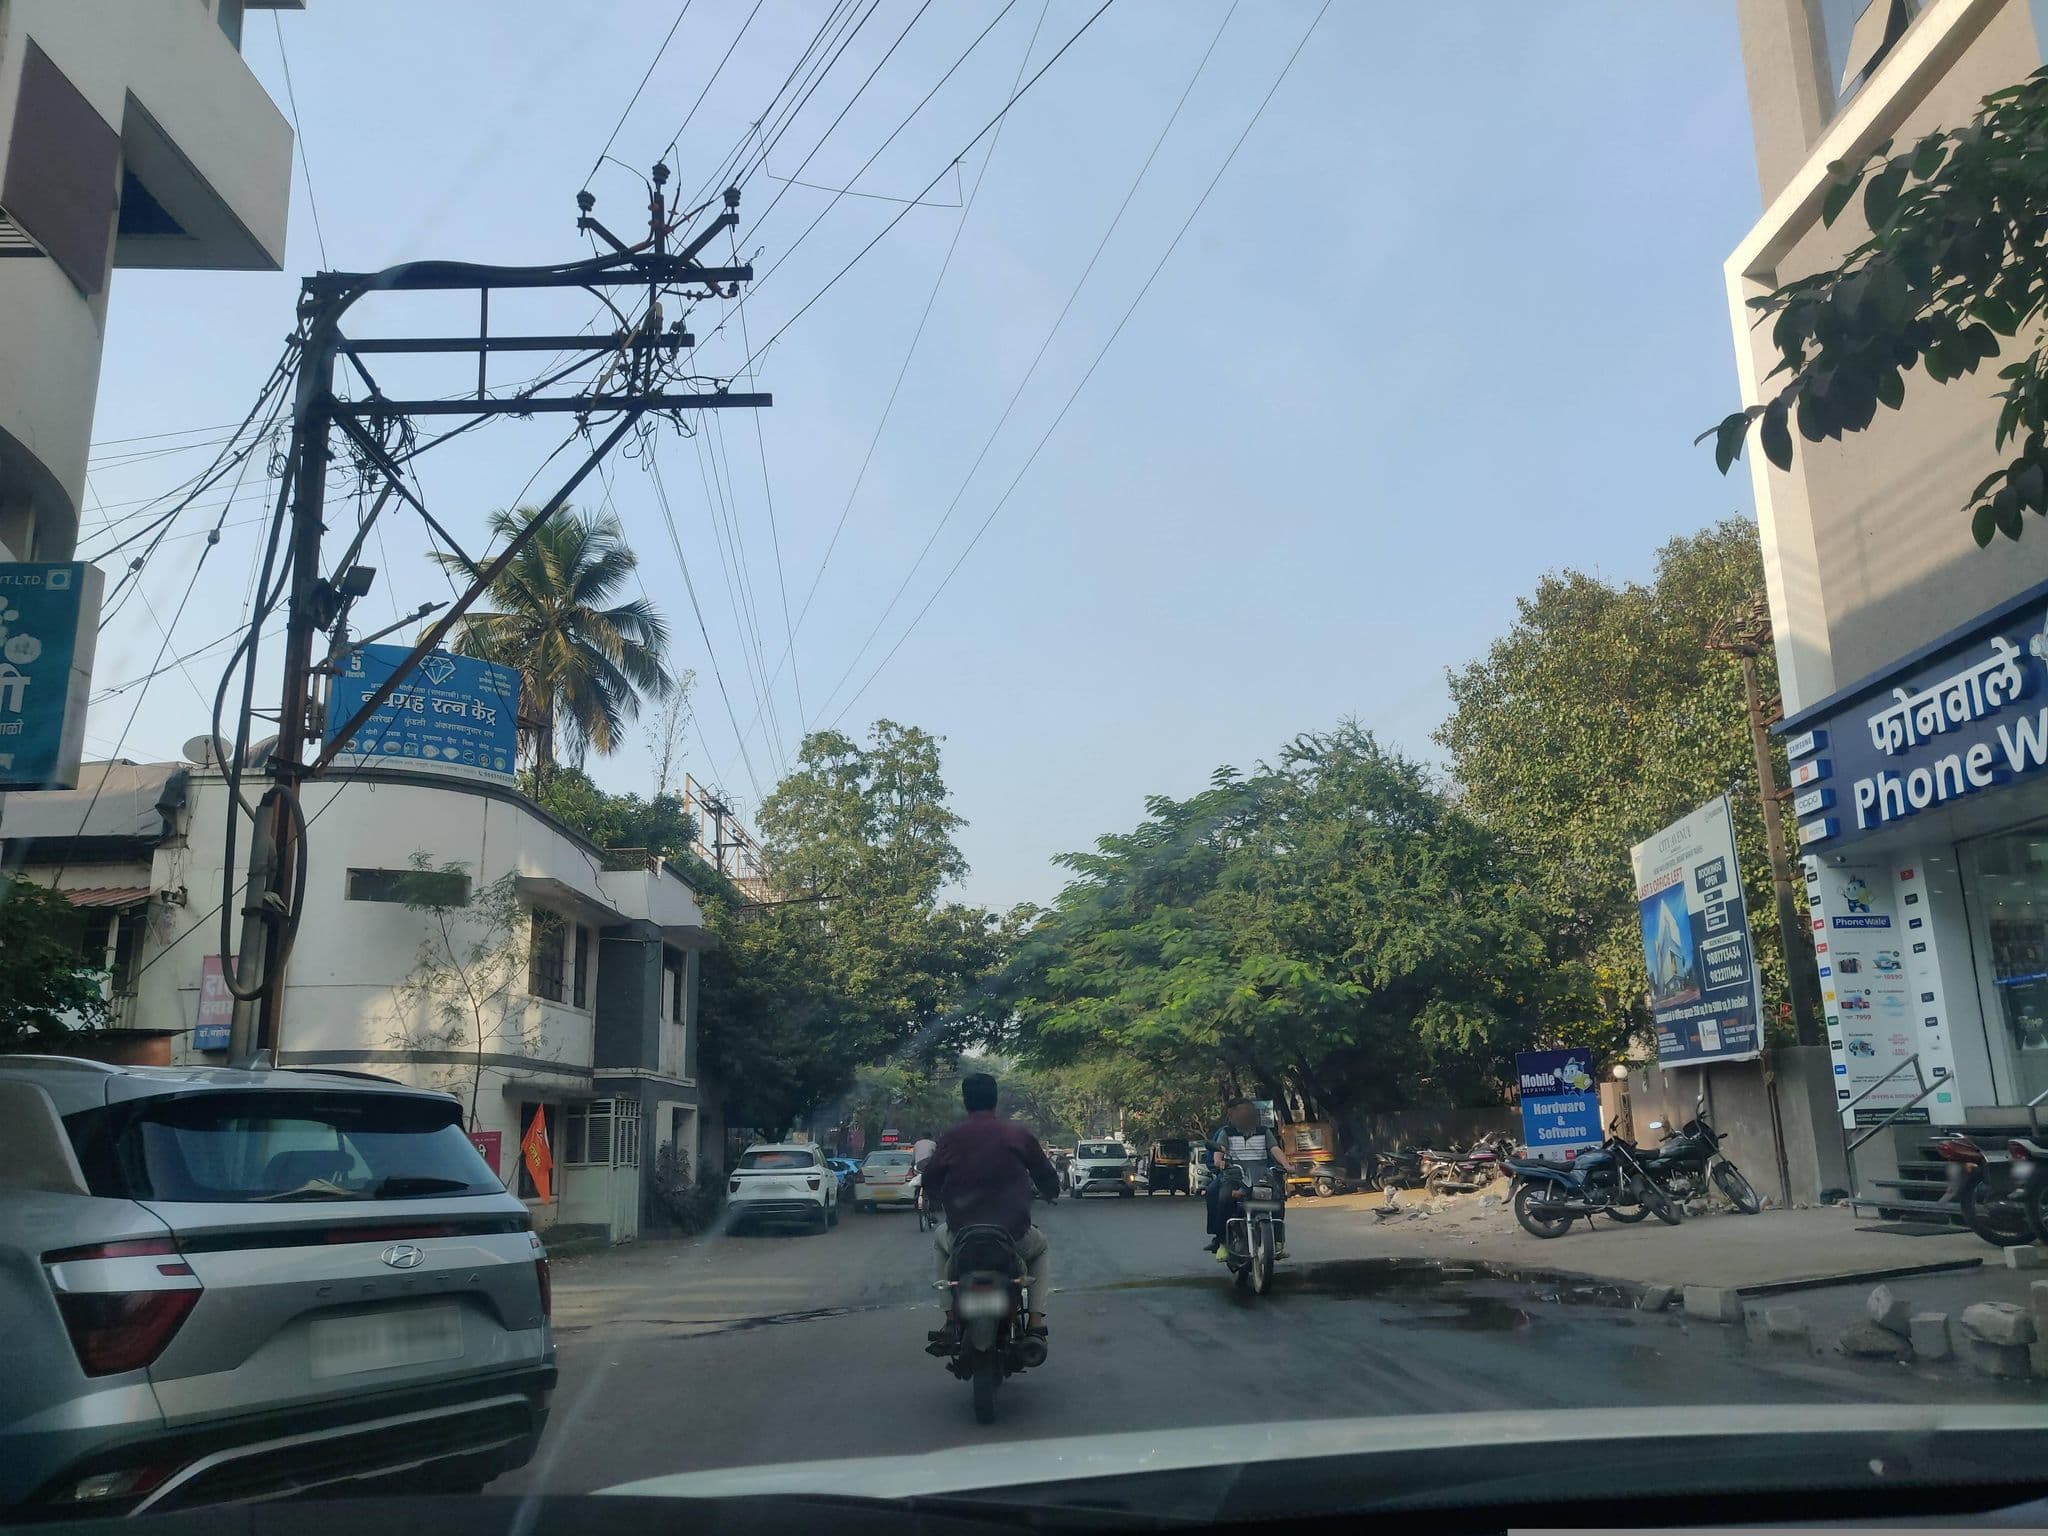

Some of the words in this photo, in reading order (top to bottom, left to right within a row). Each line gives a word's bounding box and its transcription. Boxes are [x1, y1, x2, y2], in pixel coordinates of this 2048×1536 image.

[1867, 636, 2023, 756] फोनवाले
[431, 697, 468, 717] रत्न
[471, 698, 497, 726] केंद्र
[1853, 743, 1993, 830] Phone
[1836, 918, 1864, 926] Phone
[1865, 918, 1887, 926] Wale
[1521, 1072, 1556, 1089] Mobile
[1522, 1086, 1557, 1094] REPAIRING
[1533, 1101, 1586, 1116] Hardware
[1557, 1115, 1566, 1126] &
[1538, 1126, 1587, 1140] Software
